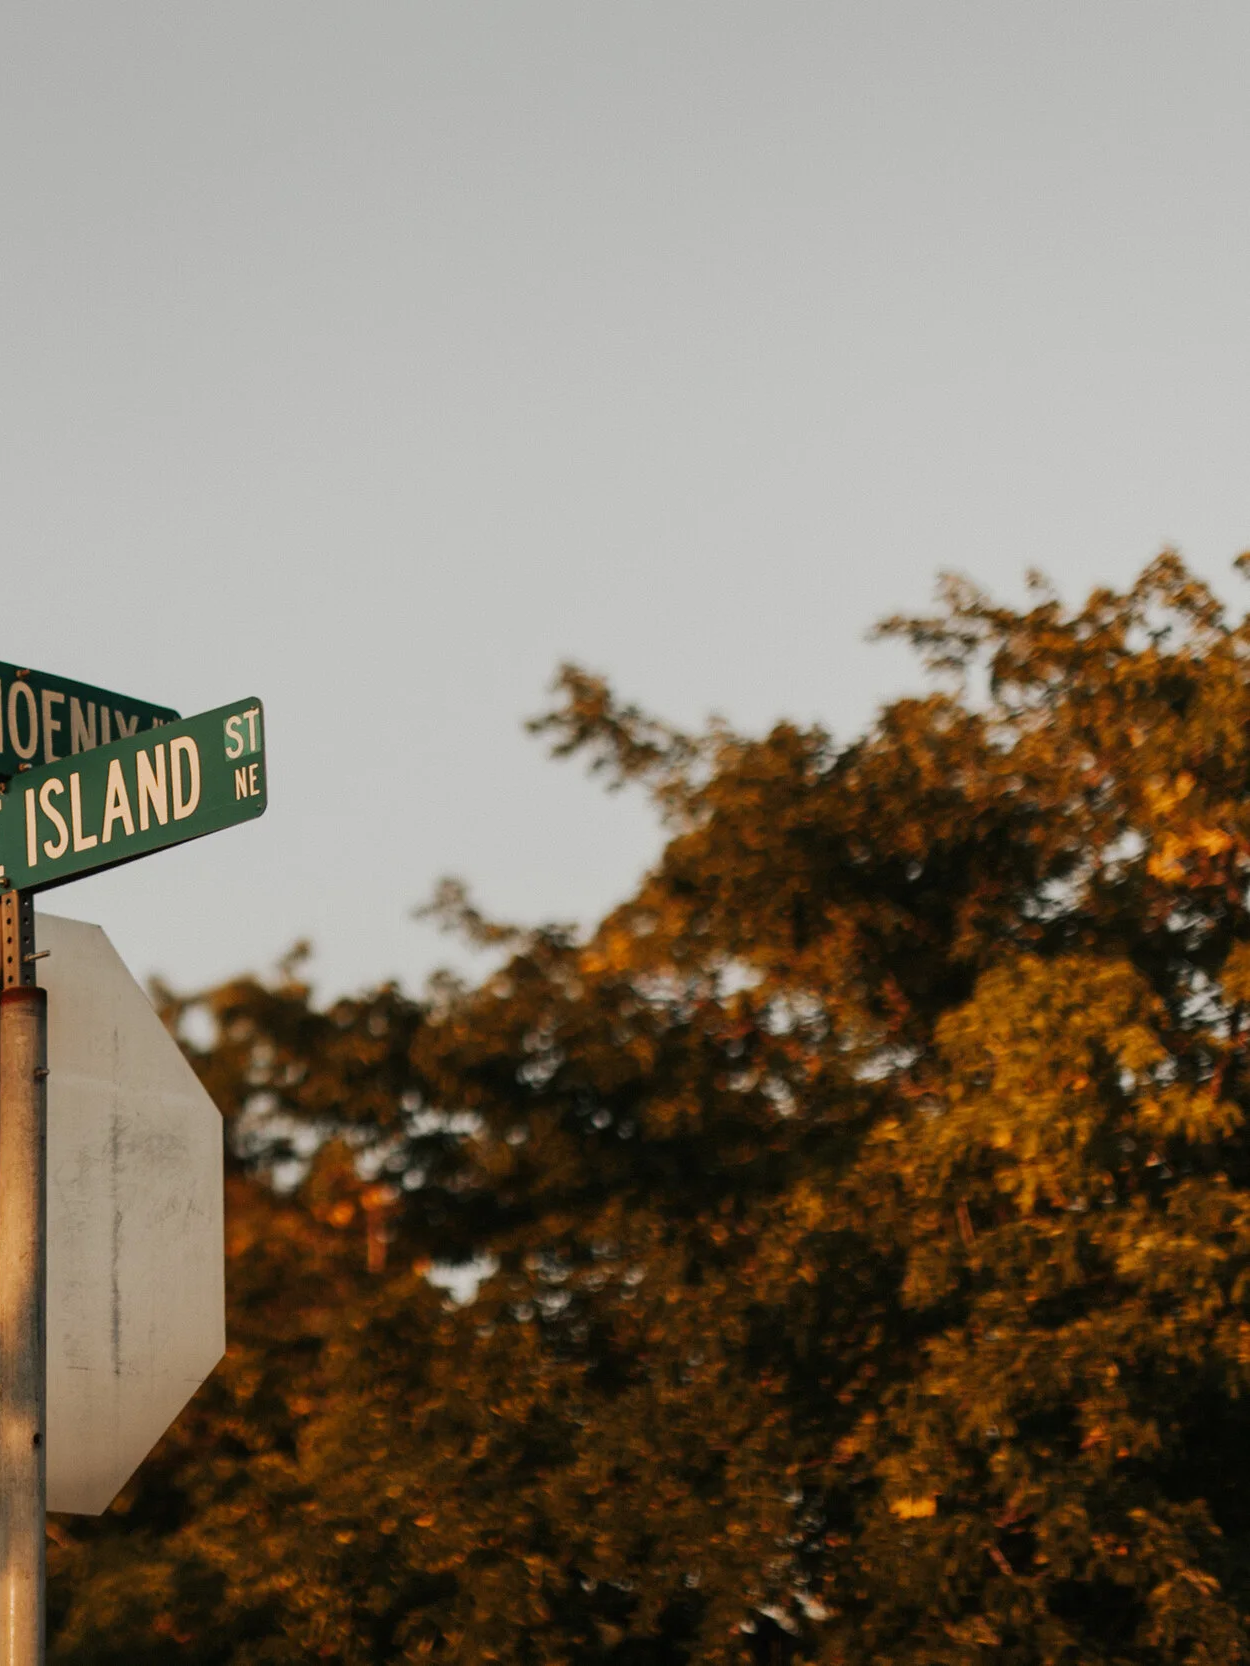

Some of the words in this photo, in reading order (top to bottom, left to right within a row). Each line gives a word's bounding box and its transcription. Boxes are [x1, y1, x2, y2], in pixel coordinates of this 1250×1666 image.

[224, 707, 261, 760] ST
[24, 735, 202, 868] ISLAND
[234, 762, 261, 801] NE
